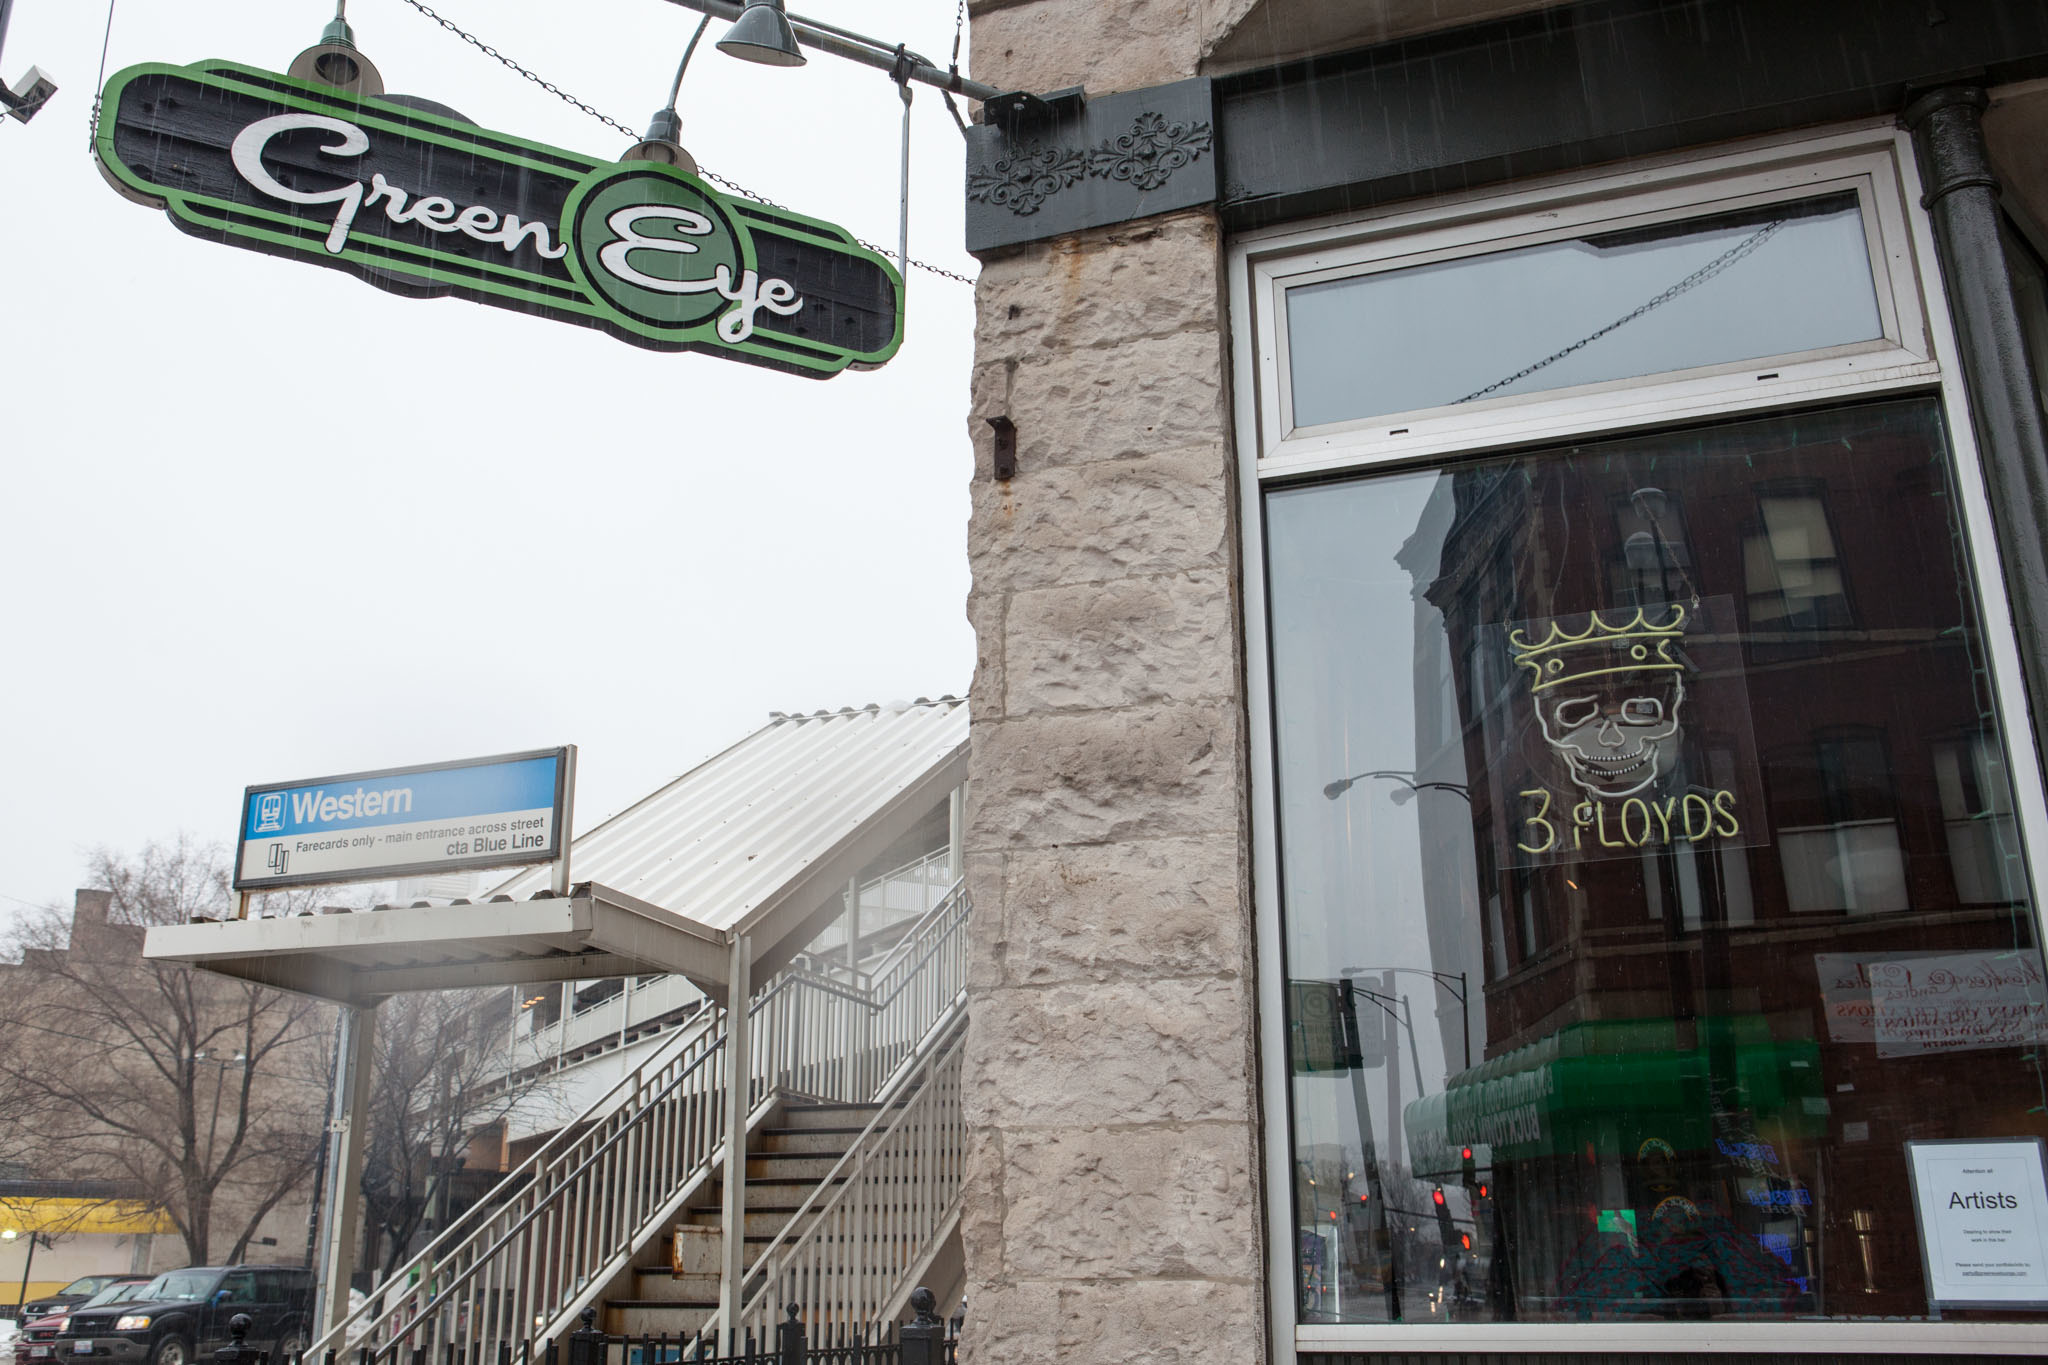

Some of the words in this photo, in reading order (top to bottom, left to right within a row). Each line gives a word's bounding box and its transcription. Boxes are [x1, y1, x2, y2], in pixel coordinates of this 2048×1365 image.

[231, 113, 568, 258] Green
[600, 205, 804, 343] Eye
[292, 787, 413, 824] Western
[1517, 788, 1555, 853] 3
[1573, 790, 1739, 850] FLOYDS
[296, 836, 349, 853] Farecards
[352, 835, 375, 850] only
[385, 830, 413, 845] main
[415, 824, 465, 841] entrance
[468, 820, 507, 836] across
[510, 816, 544, 832] street
[446, 840, 468, 856] cta
[474, 836, 507, 853] Blue
[512, 832, 544, 849] Line
[1949, 1191, 2018, 1209] Artists
